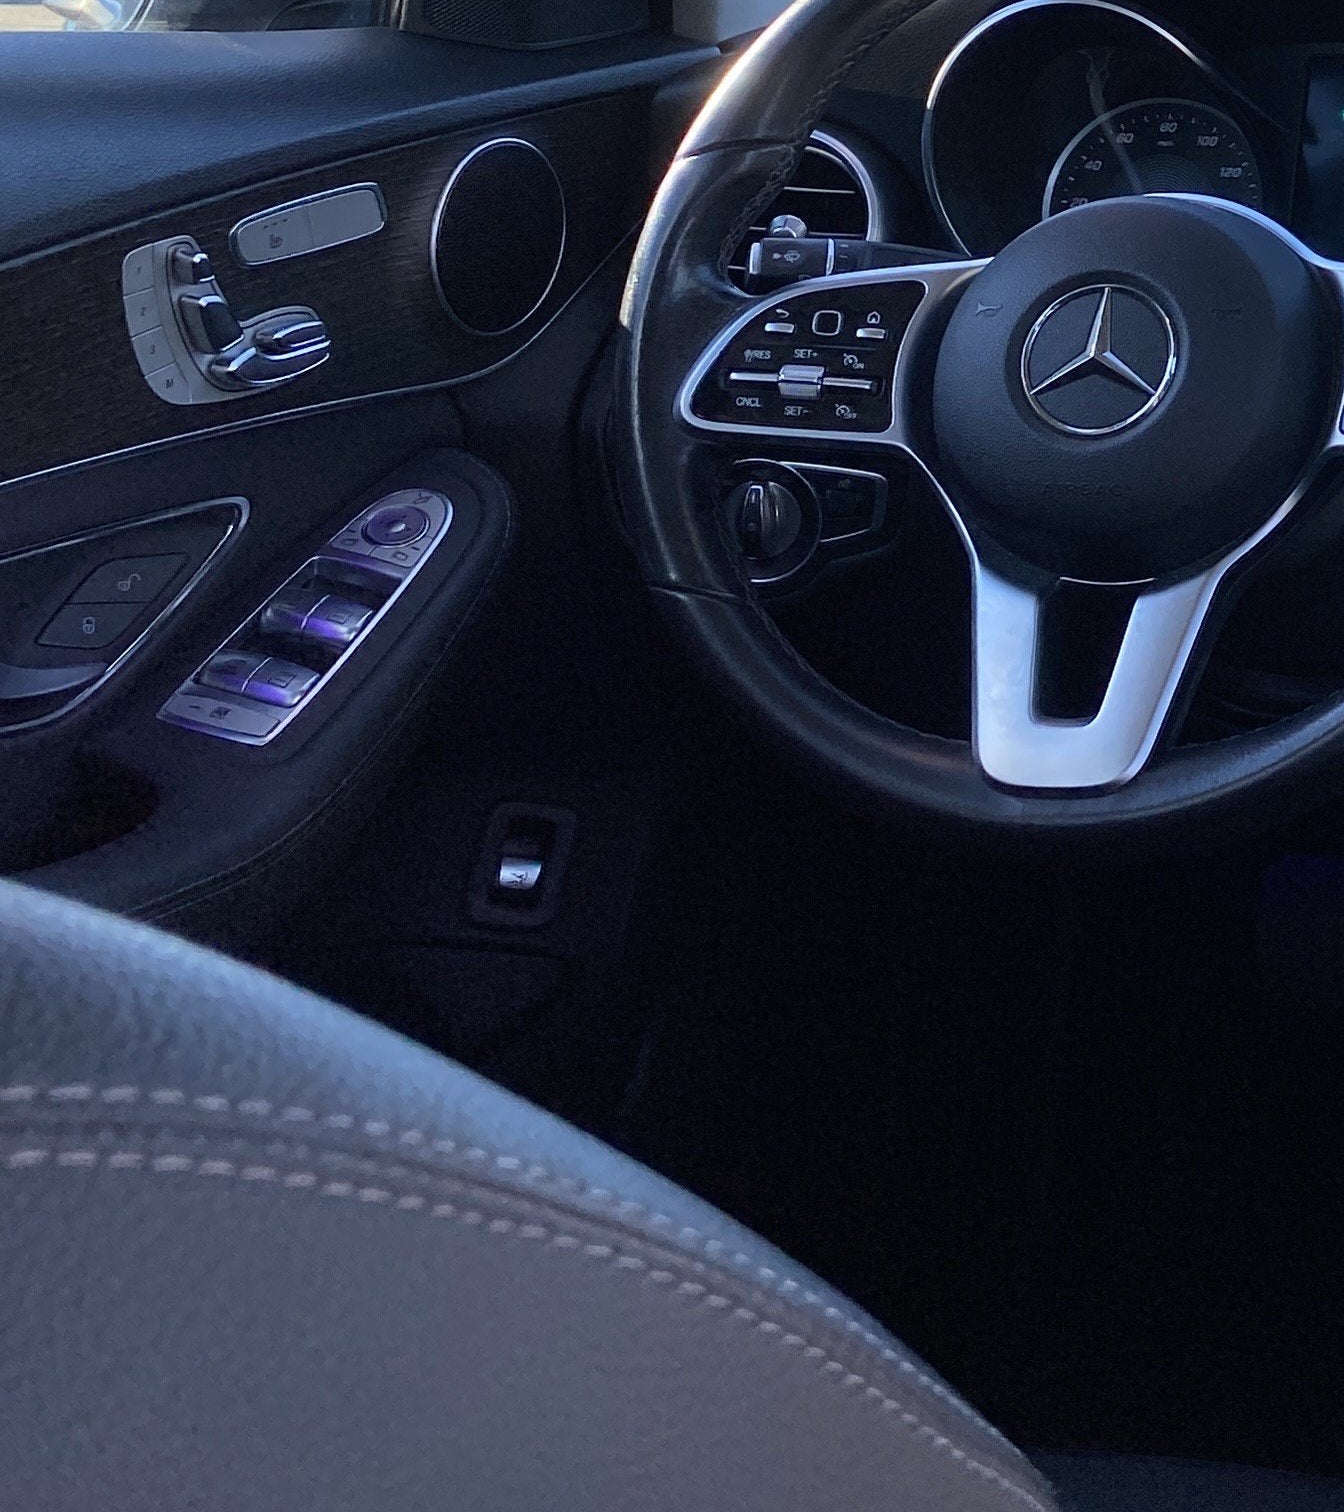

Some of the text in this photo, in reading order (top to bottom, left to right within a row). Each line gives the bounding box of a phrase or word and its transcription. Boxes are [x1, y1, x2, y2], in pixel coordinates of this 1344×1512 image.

[1197, 136, 1218, 147] 100
[1084, 160, 1102, 171] 40
[1220, 167, 1242, 178] 120
[735, 396, 762, 407] CNCL
